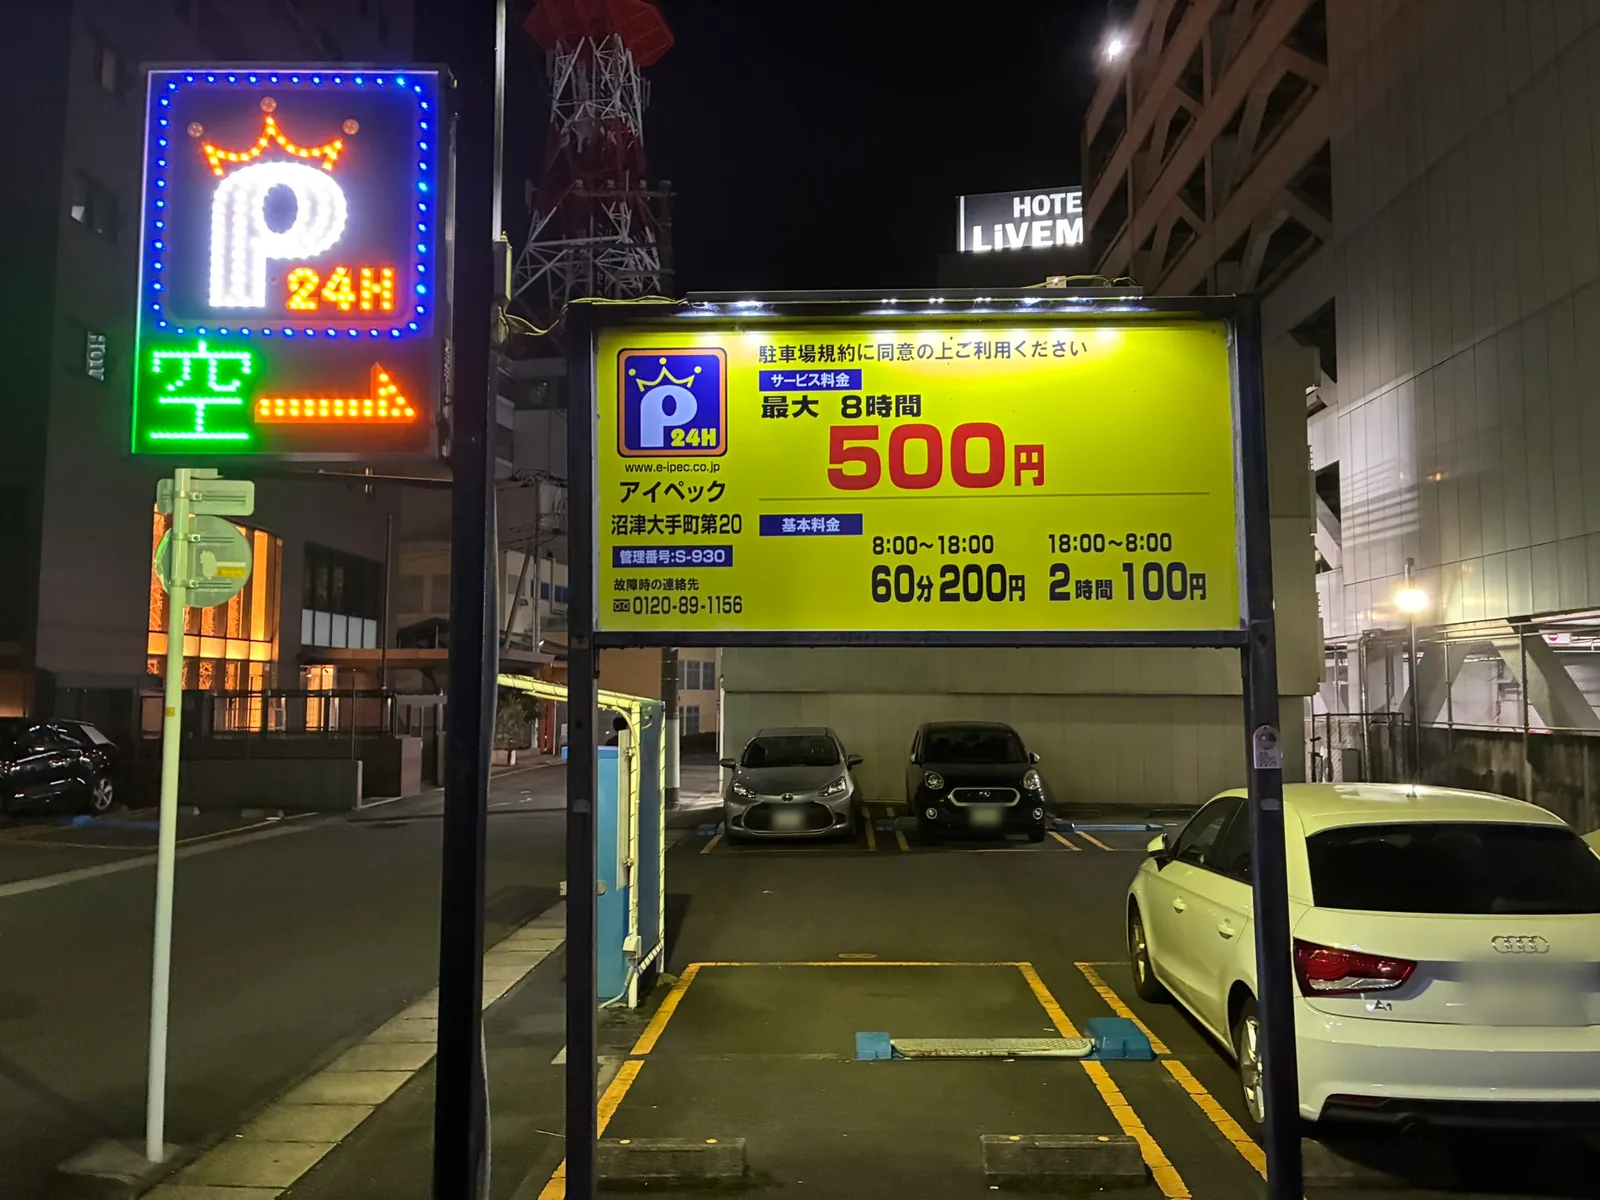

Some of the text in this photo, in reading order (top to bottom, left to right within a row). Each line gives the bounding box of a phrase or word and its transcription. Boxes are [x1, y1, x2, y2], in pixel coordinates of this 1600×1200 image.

[1013, 191, 1083, 218] HOTE
[209, 161, 347, 308] P
[285, 265, 395, 311] 24H
[758, 339, 1088, 364] 駐車場規約に同意の上ご利用ください
[148, 339, 253, 440] 空
[770, 371, 850, 388] サービス料金
[761, 394, 922, 419] 最大 8時間
[670, 428, 717, 448] 24H
[625, 461, 720, 473] www.e-ipec.co.jp
[618, 480, 726, 504] アイペック
[611, 513, 742, 536] 沼津大手町第20
[781, 517, 841, 533] 基本料金
[619, 549, 726, 565] 管理番号:S-930
[613, 578, 700, 592] 故障時の連絡先
[632, 595, 743, 615] 0120-89-1156
